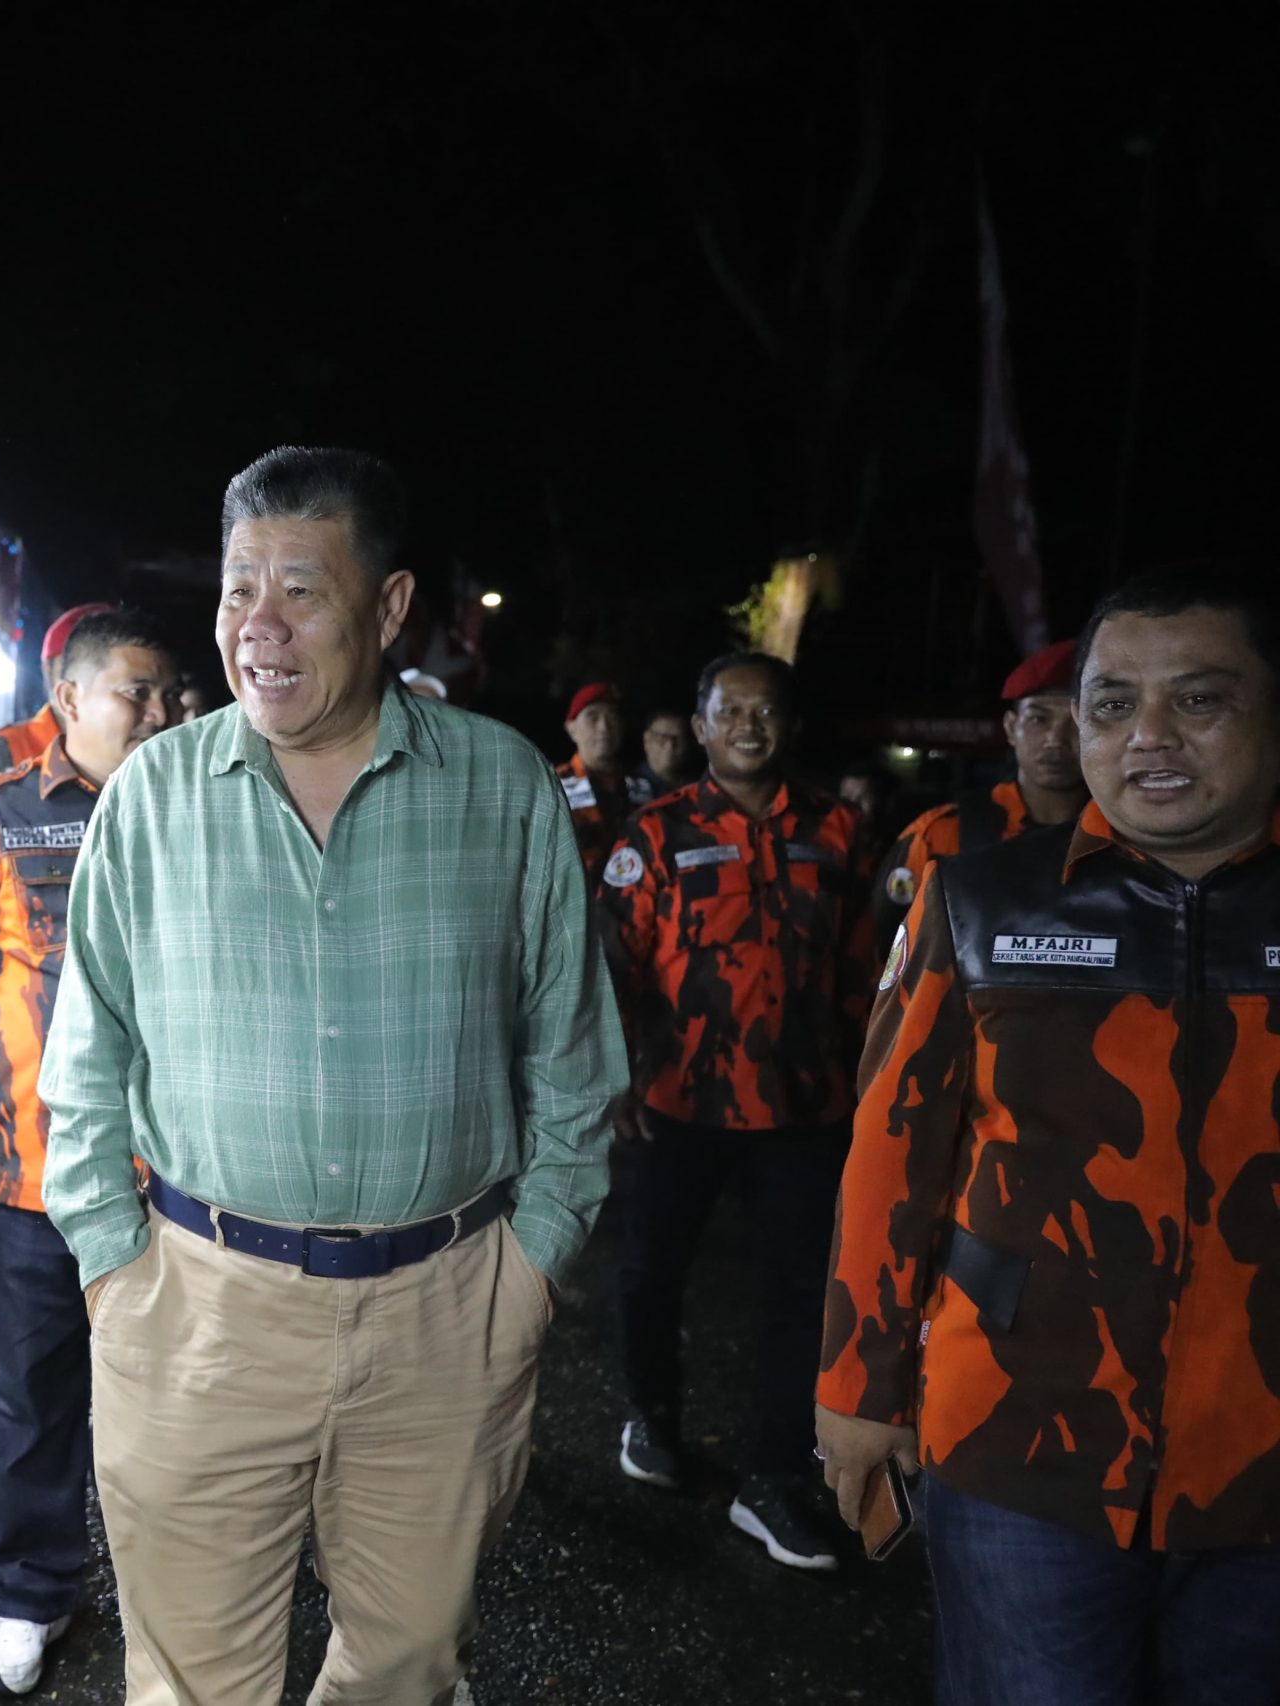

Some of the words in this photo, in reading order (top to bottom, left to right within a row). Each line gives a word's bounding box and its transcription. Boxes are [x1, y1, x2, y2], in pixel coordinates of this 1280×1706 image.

[1011, 937, 1092, 951] M.FAJRI
[993, 952, 1035, 961] SEKRETARIS
[1269, 950, 1280, 965] P
